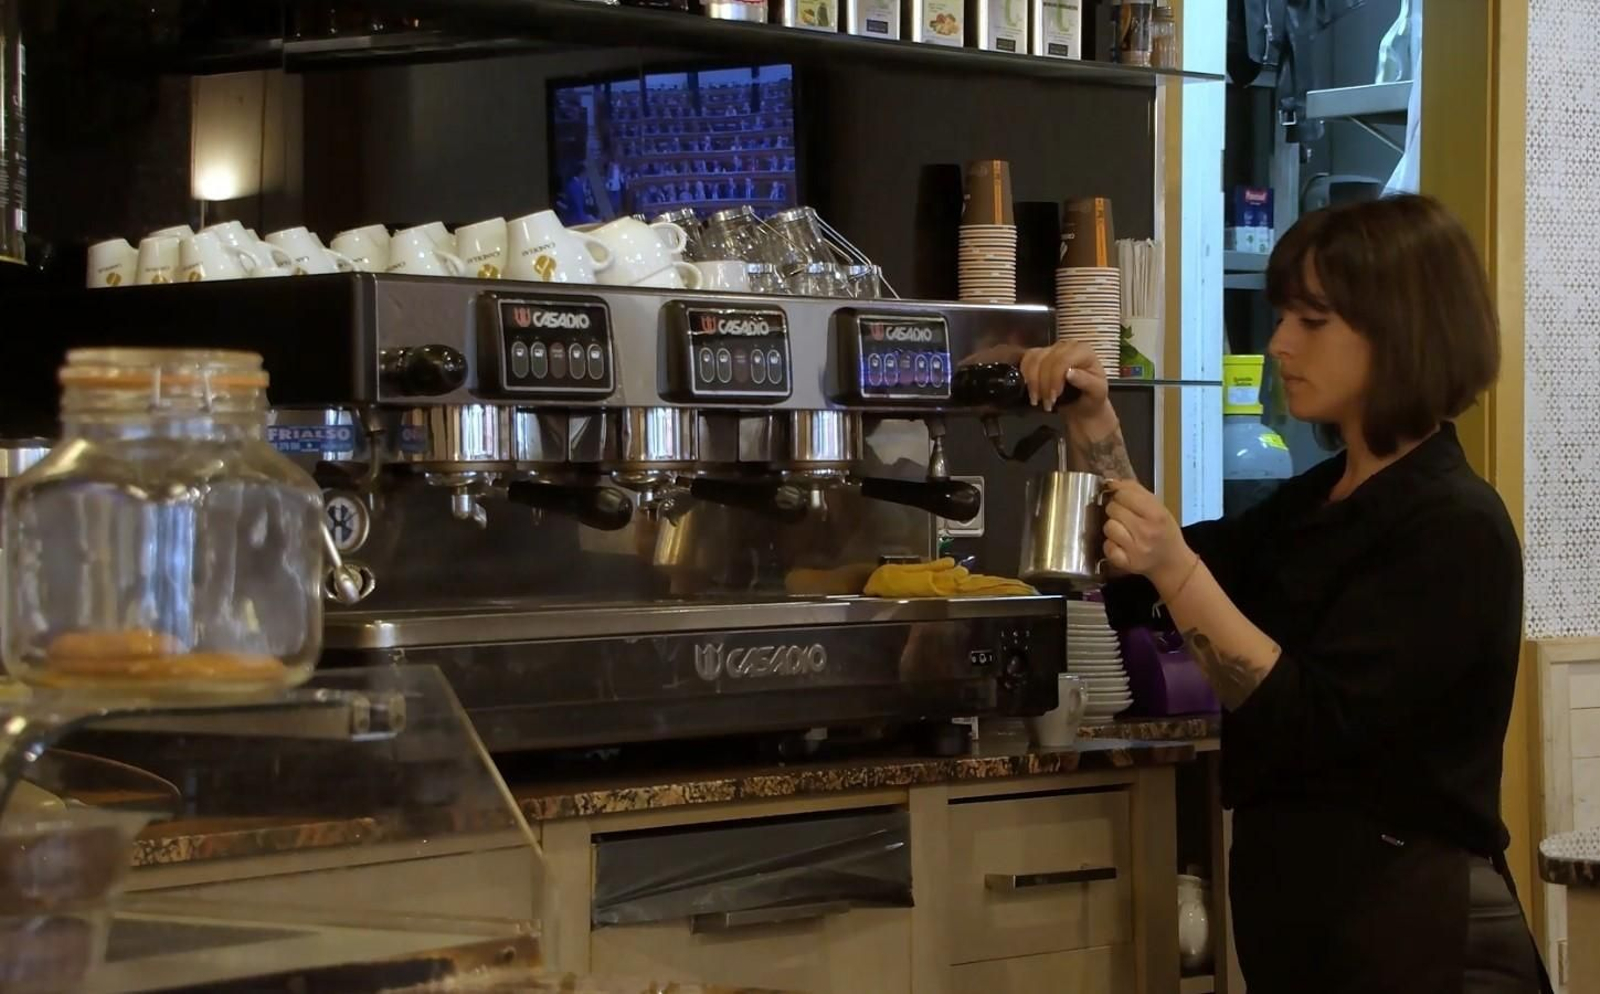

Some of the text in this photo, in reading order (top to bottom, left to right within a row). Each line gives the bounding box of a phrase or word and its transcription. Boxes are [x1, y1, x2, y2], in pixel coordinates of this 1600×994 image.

[533, 312, 590, 329] CASADIO
[718, 319, 770, 336] CASADIO
[885, 326, 932, 342] CASADIO
[267, 428, 350, 441] FRIALSO
[726, 643, 827, 678] CASADIO
